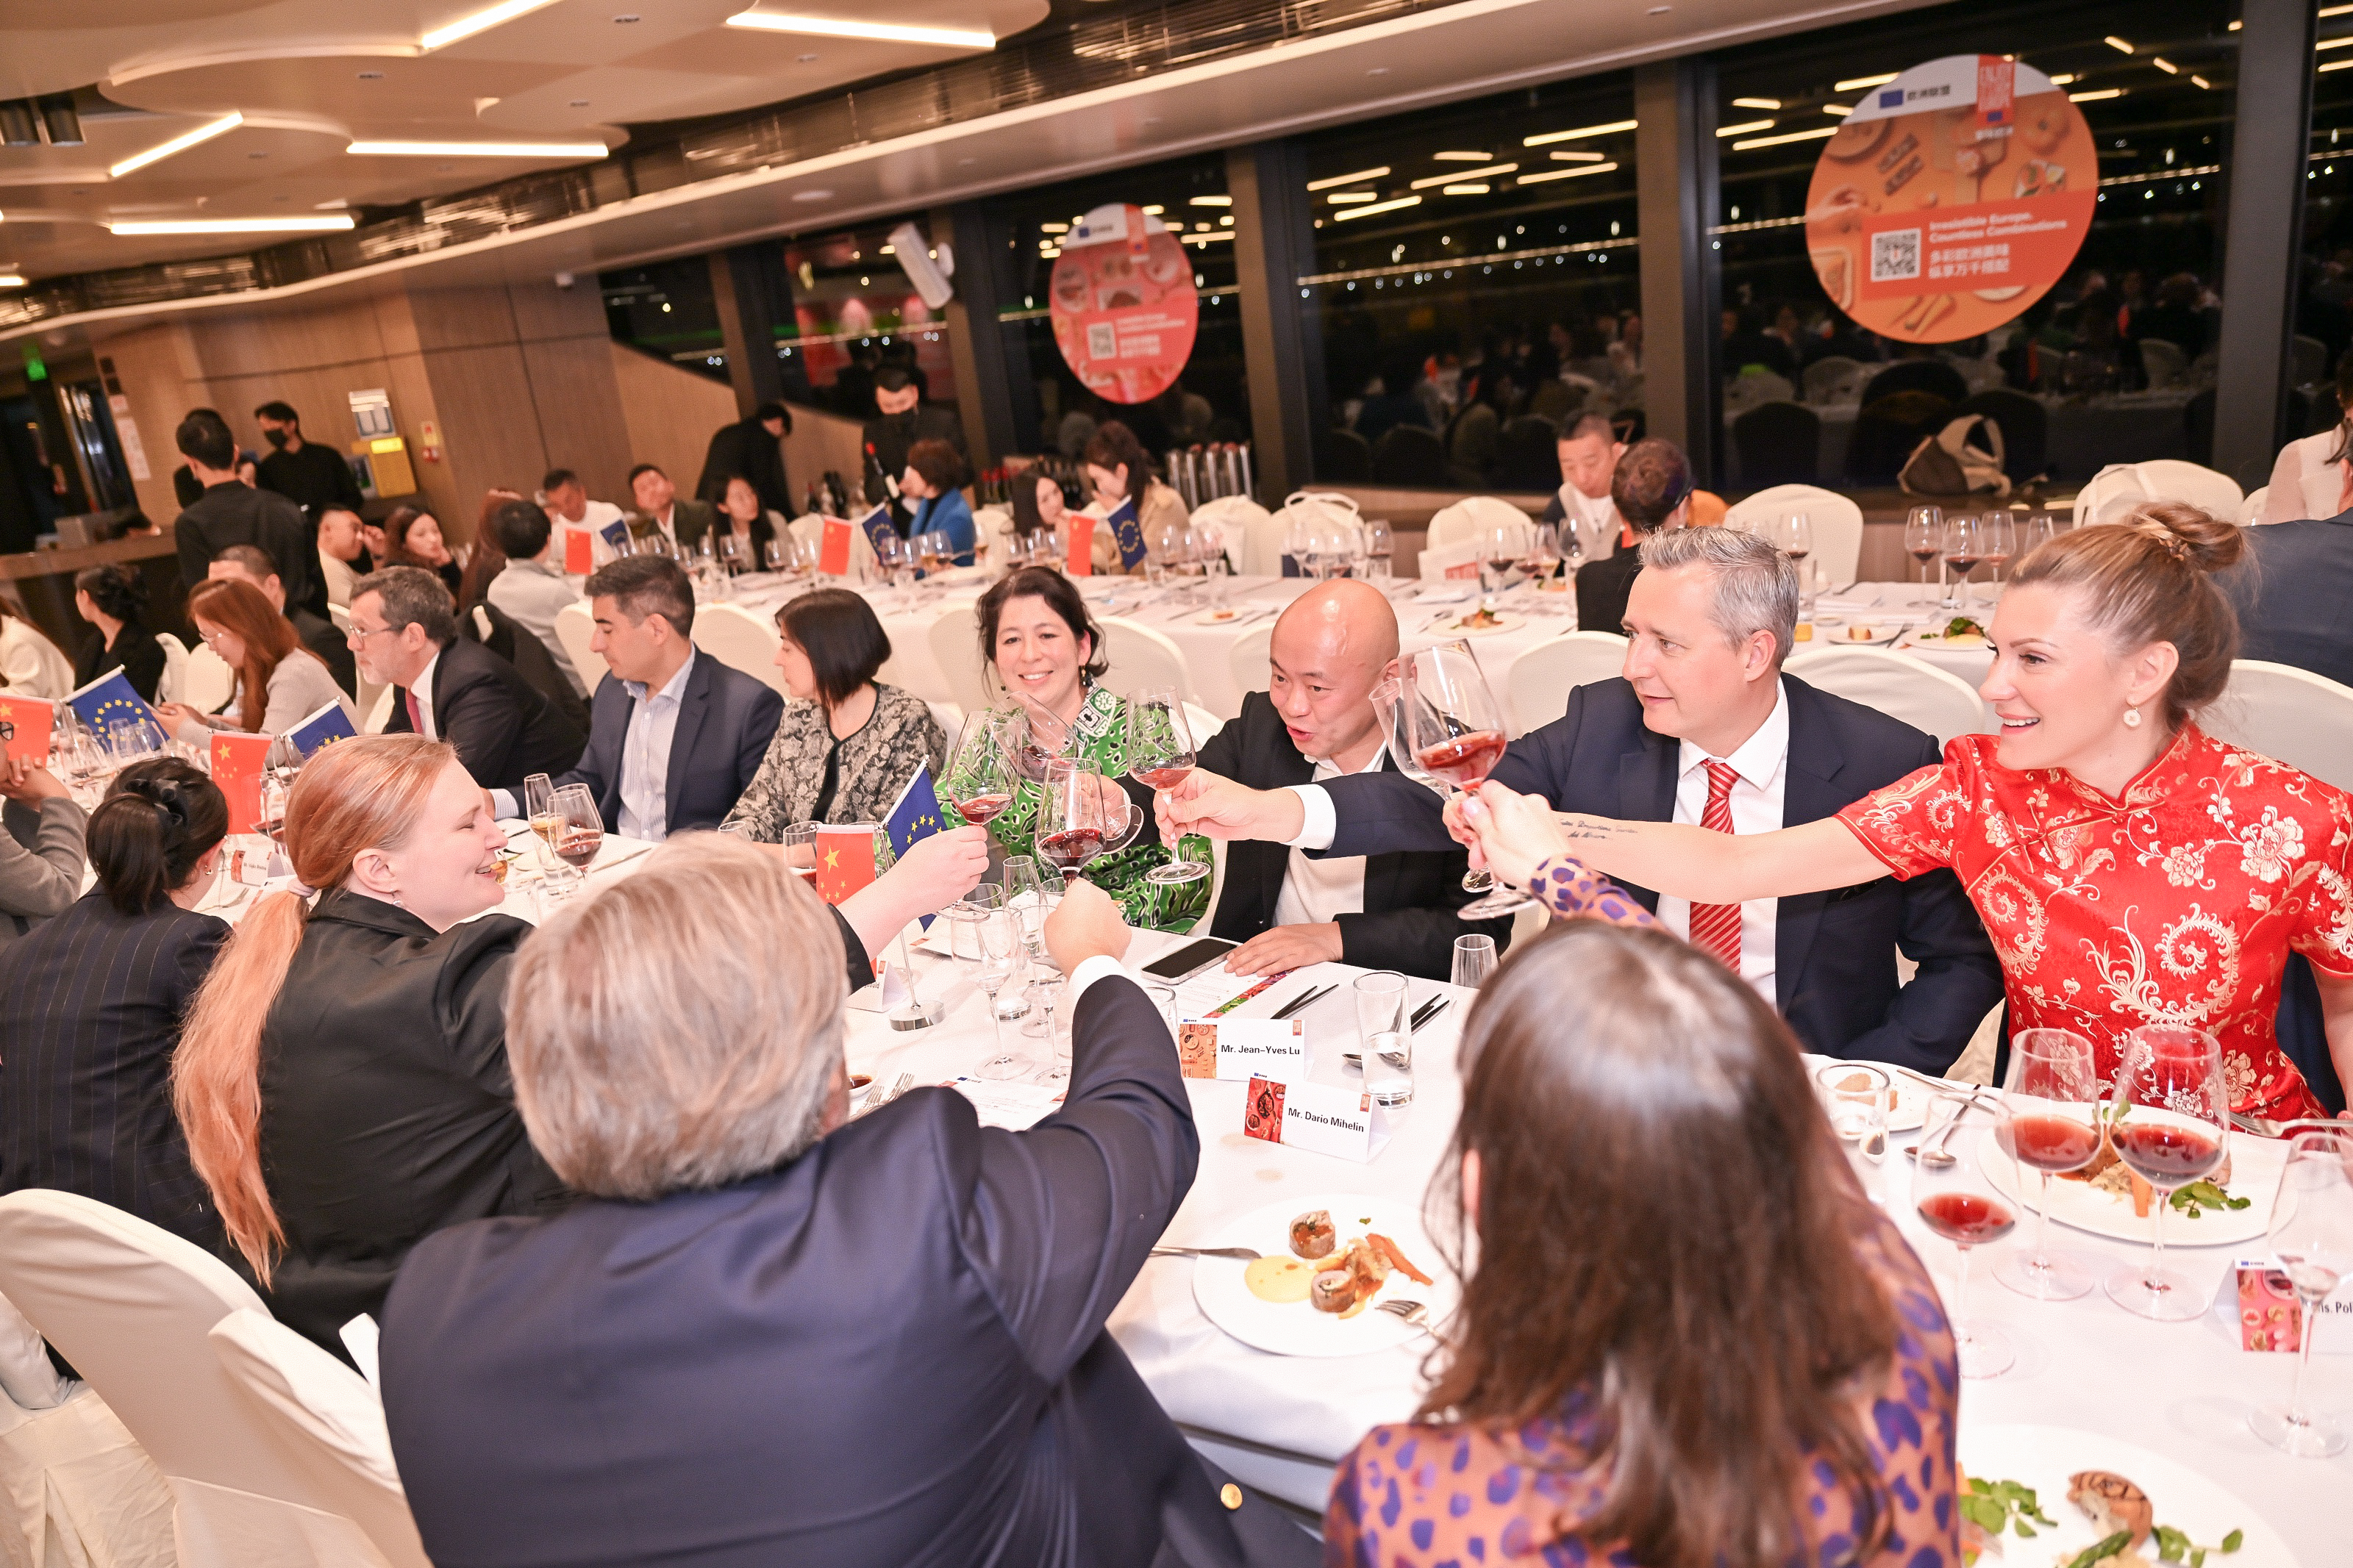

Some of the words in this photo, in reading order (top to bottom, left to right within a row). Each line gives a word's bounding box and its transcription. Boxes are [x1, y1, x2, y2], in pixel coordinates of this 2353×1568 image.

[1221, 1045, 1236, 1053] Mr.
[1238, 1045, 1287, 1054] Jean-Yves
[1289, 1046, 1300, 1055] Lu
[1288, 1107, 1303, 1118] Mr.
[1304, 1111, 1329, 1124] Dario
[1330, 1117, 1364, 1132] Mihelin
